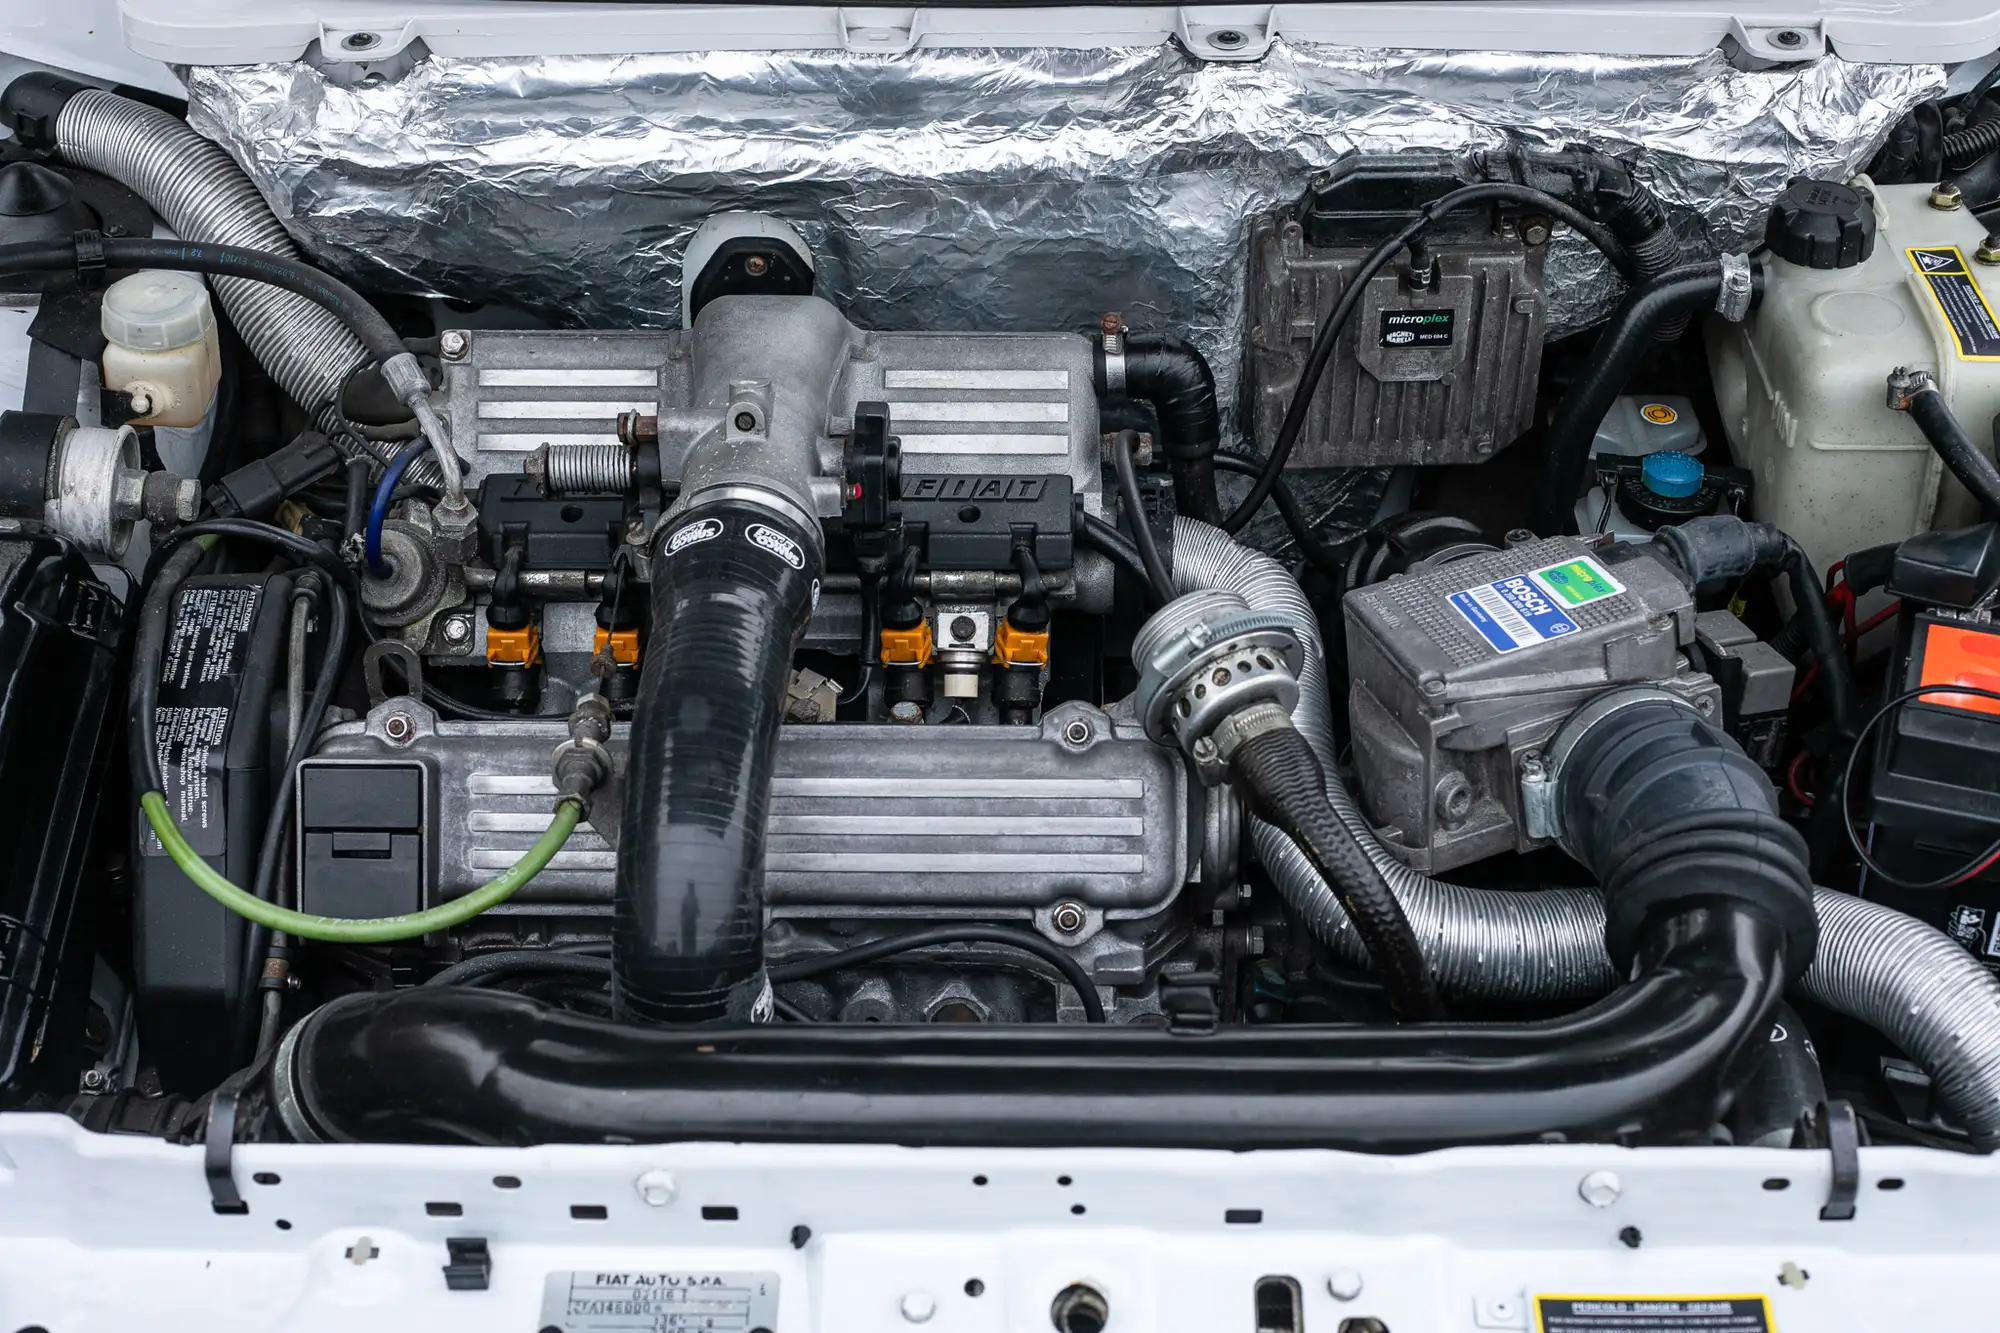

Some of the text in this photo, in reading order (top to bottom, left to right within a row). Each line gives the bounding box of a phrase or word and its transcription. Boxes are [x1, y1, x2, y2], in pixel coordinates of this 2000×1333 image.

[1389, 314, 1449, 324] microplex
[914, 479, 1038, 497] FIAT
[672, 527, 716, 550] SAMCO
[754, 533, 799, 566] SAMCO
[205, 591, 218, 628] ATTENTION
[241, 592, 255, 632] ATTENZIONE
[1504, 578, 1552, 615] BOSCH
[177, 708, 190, 741] ACHTUNG
[214, 707, 228, 745] ATTENTION
[179, 748, 187, 785] workshop
[193, 748, 201, 767] angle
[200, 745, 209, 773] cylinder
[596, 1274, 630, 1285] FIAT
[635, 1275, 680, 1286] AUTO
